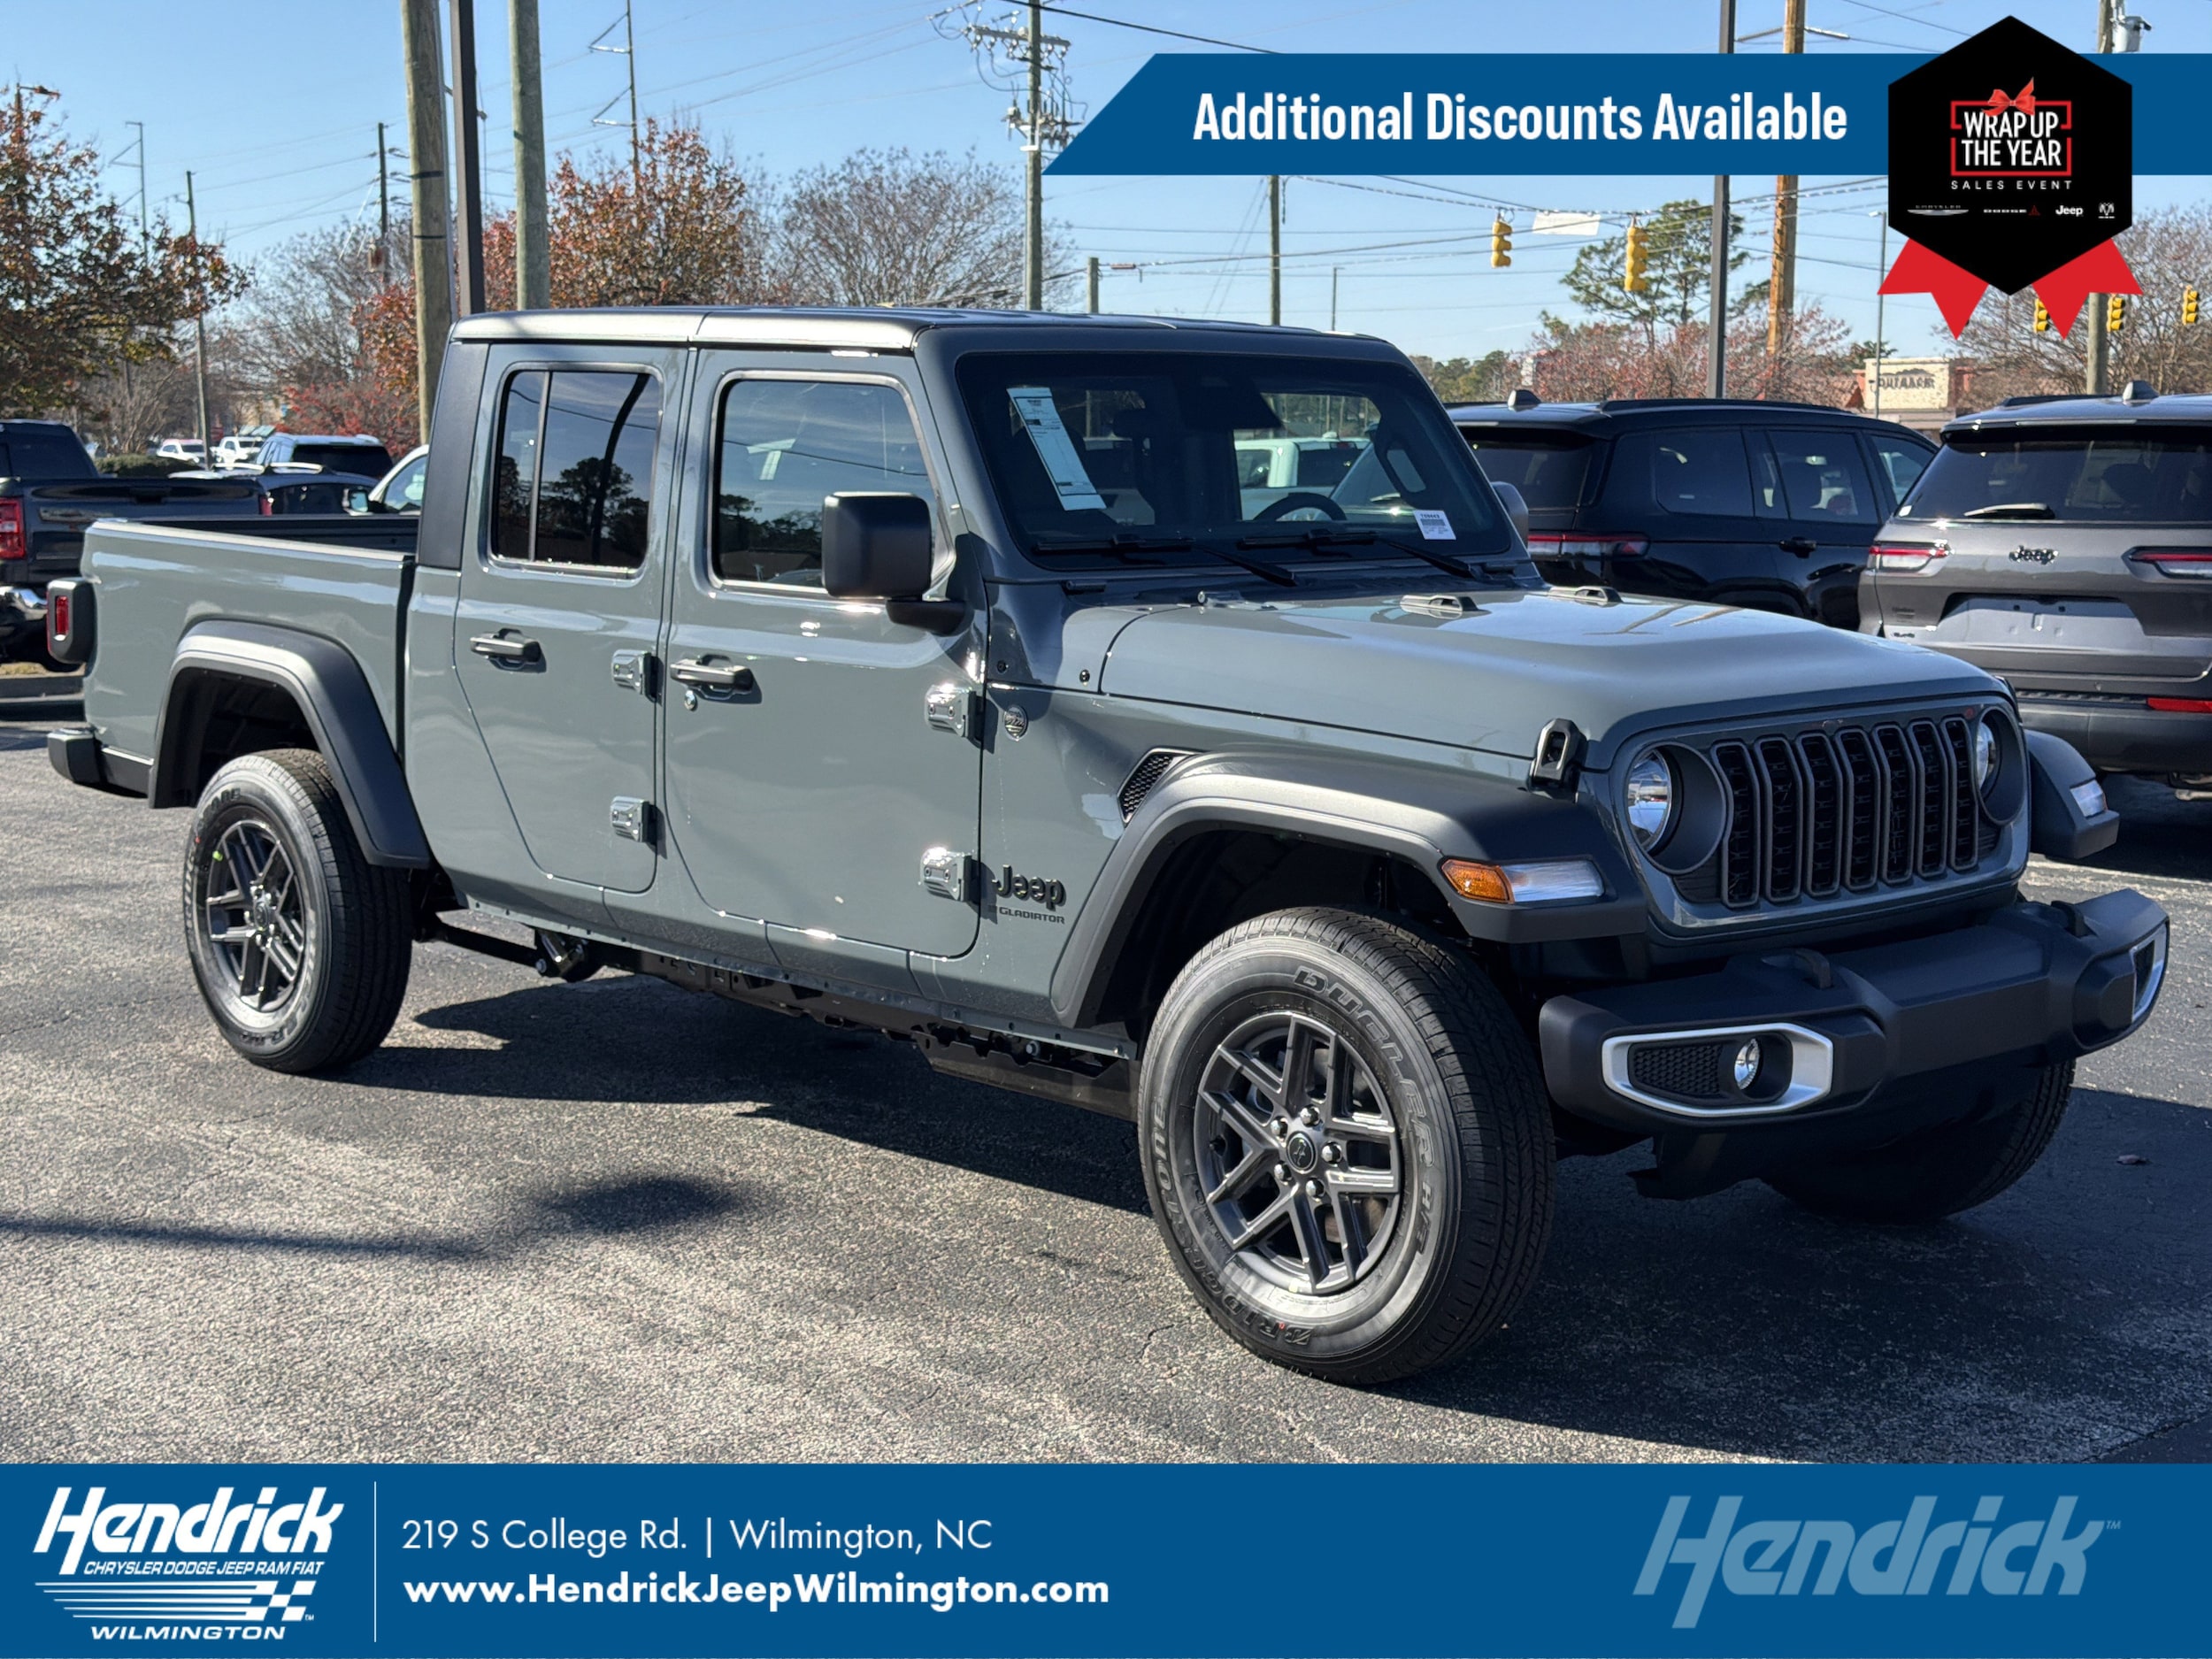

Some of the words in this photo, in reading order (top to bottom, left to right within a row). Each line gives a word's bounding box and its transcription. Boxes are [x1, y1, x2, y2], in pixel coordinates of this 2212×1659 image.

[2009, 545, 2060, 565] Jeep
[991, 864, 1067, 911] Jeep
[999, 906, 1066, 925] GLADIATOR
